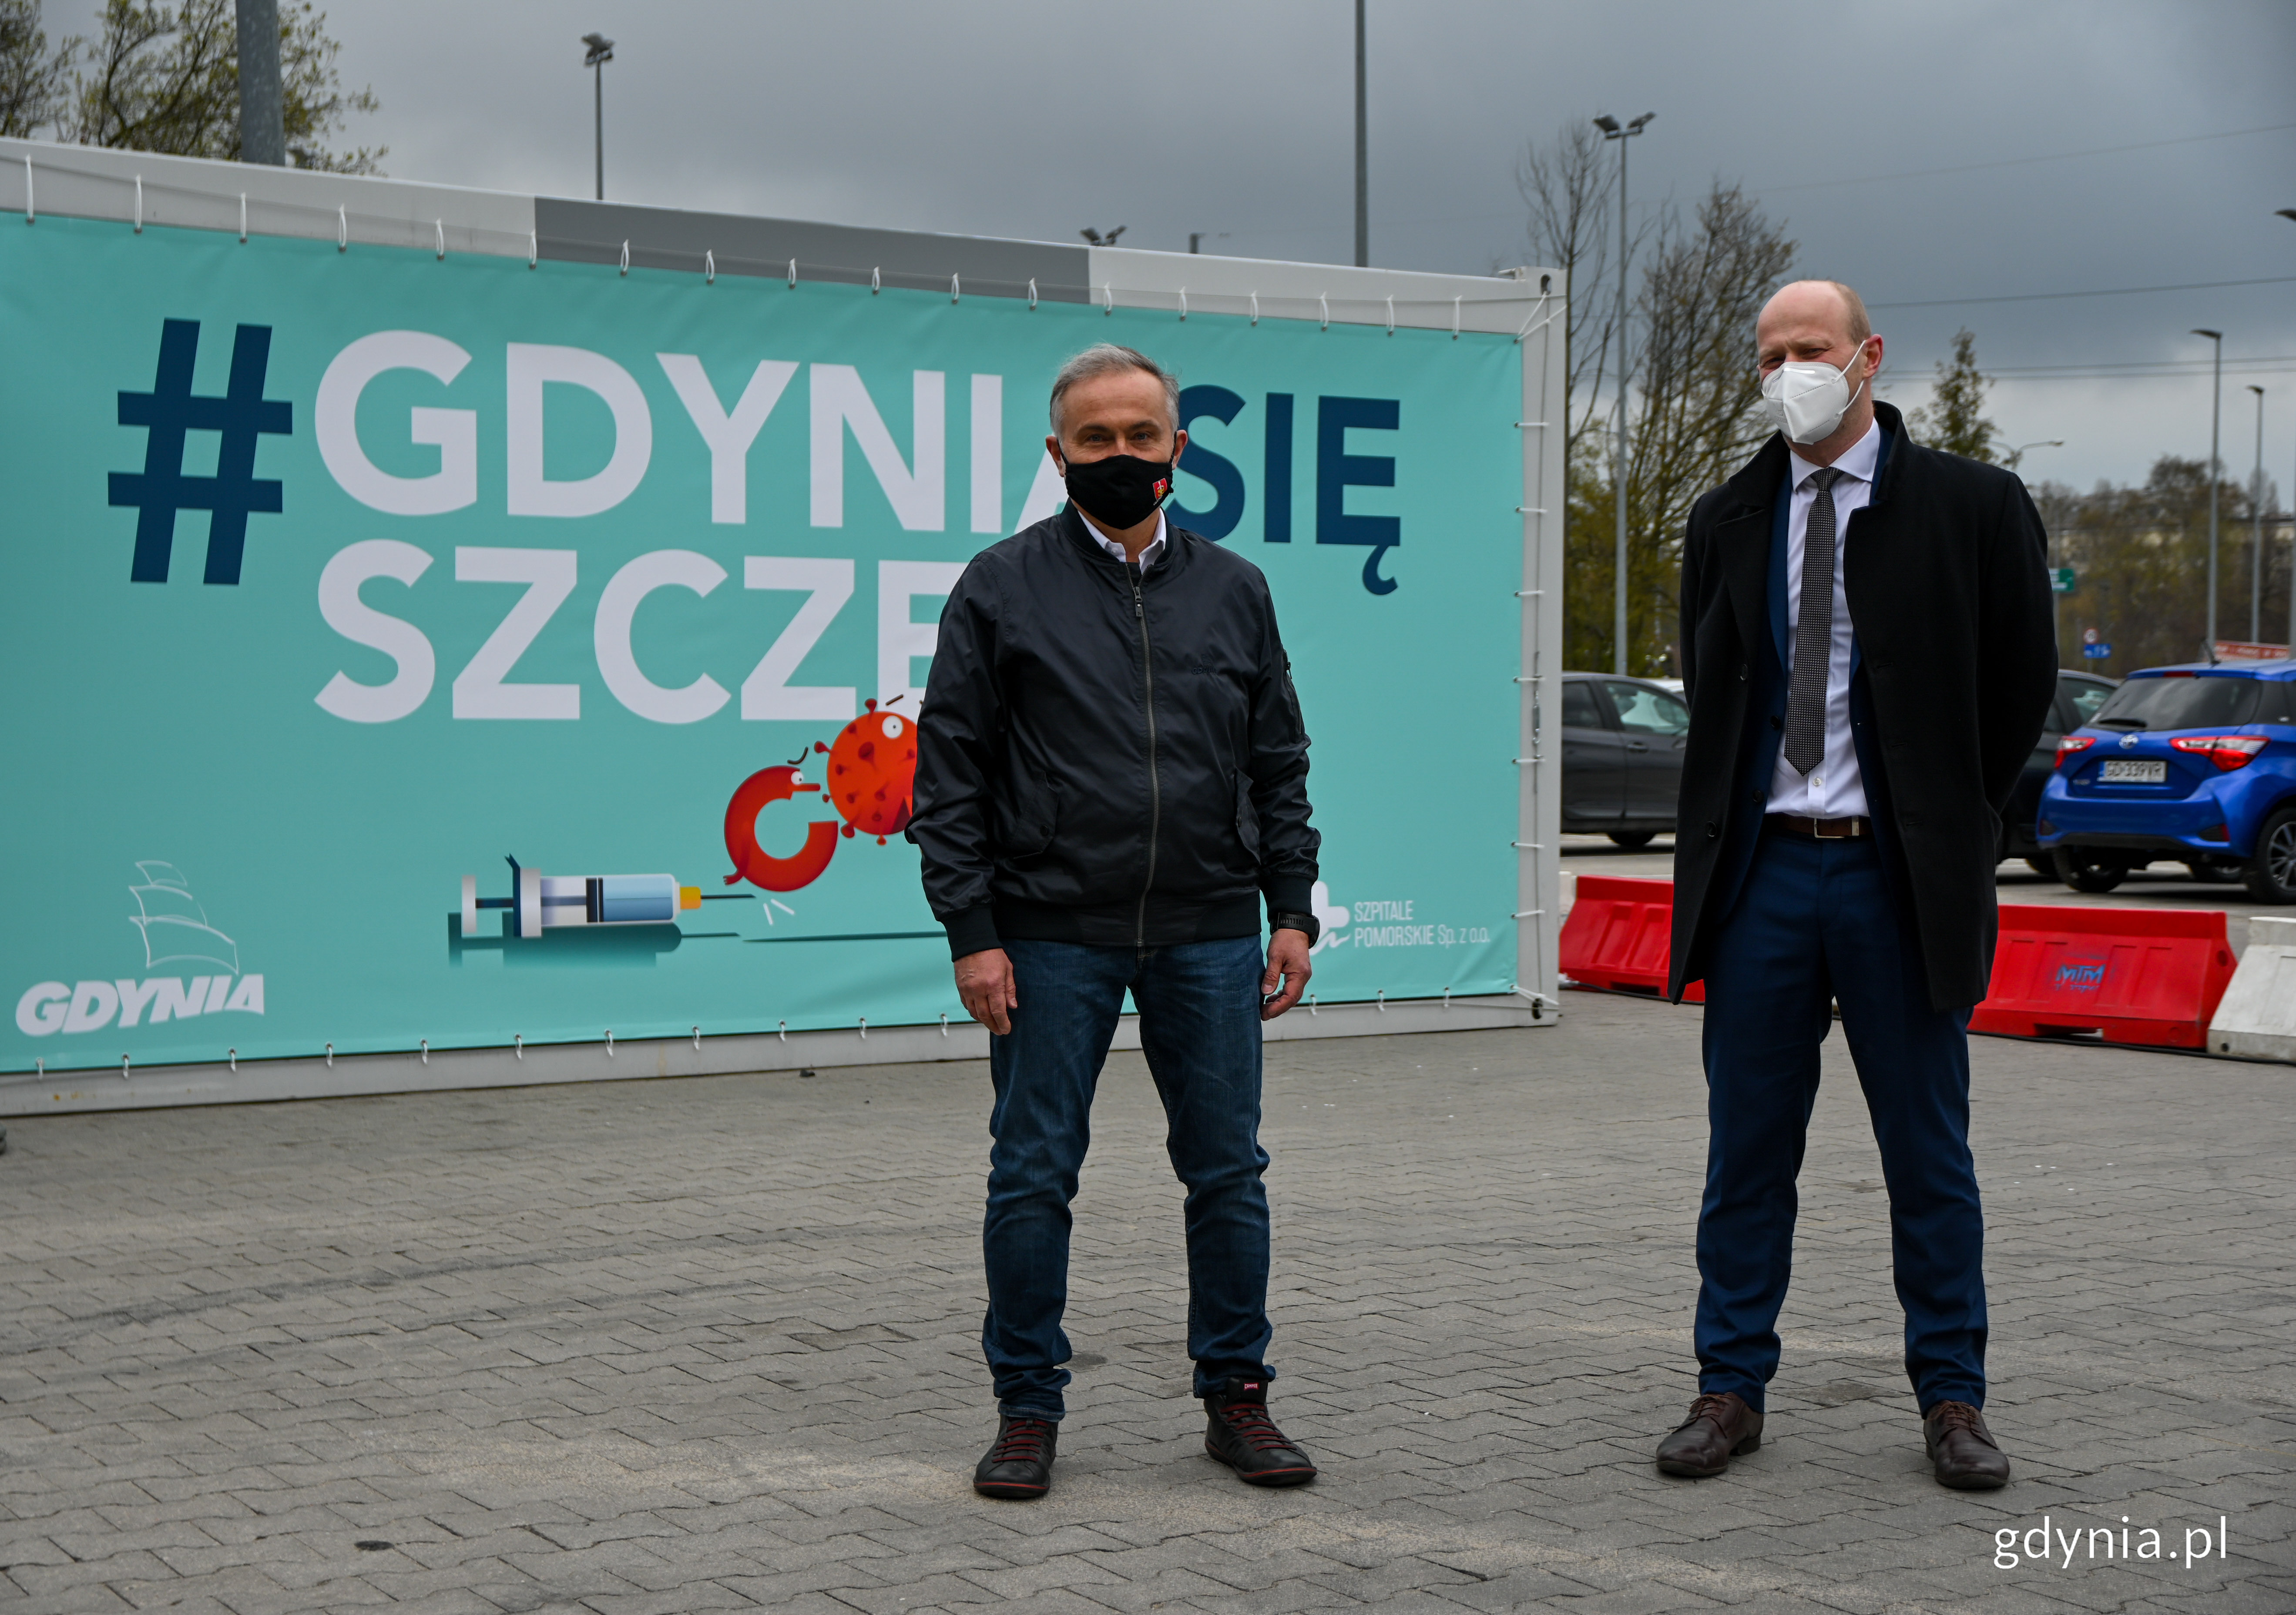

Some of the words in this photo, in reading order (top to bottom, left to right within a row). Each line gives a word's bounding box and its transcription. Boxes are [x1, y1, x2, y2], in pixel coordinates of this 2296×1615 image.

[1165, 385, 1400, 595] SIĘ
[314, 539, 970, 724] SZCZE
[1354, 900, 1413, 922] SZPITALE
[1354, 925, 1435, 948] POMORSKIE
[1437, 924, 1456, 949] Sp.
[1469, 927, 1491, 943] o.o.
[15, 973, 265, 1036] GDYNIA
